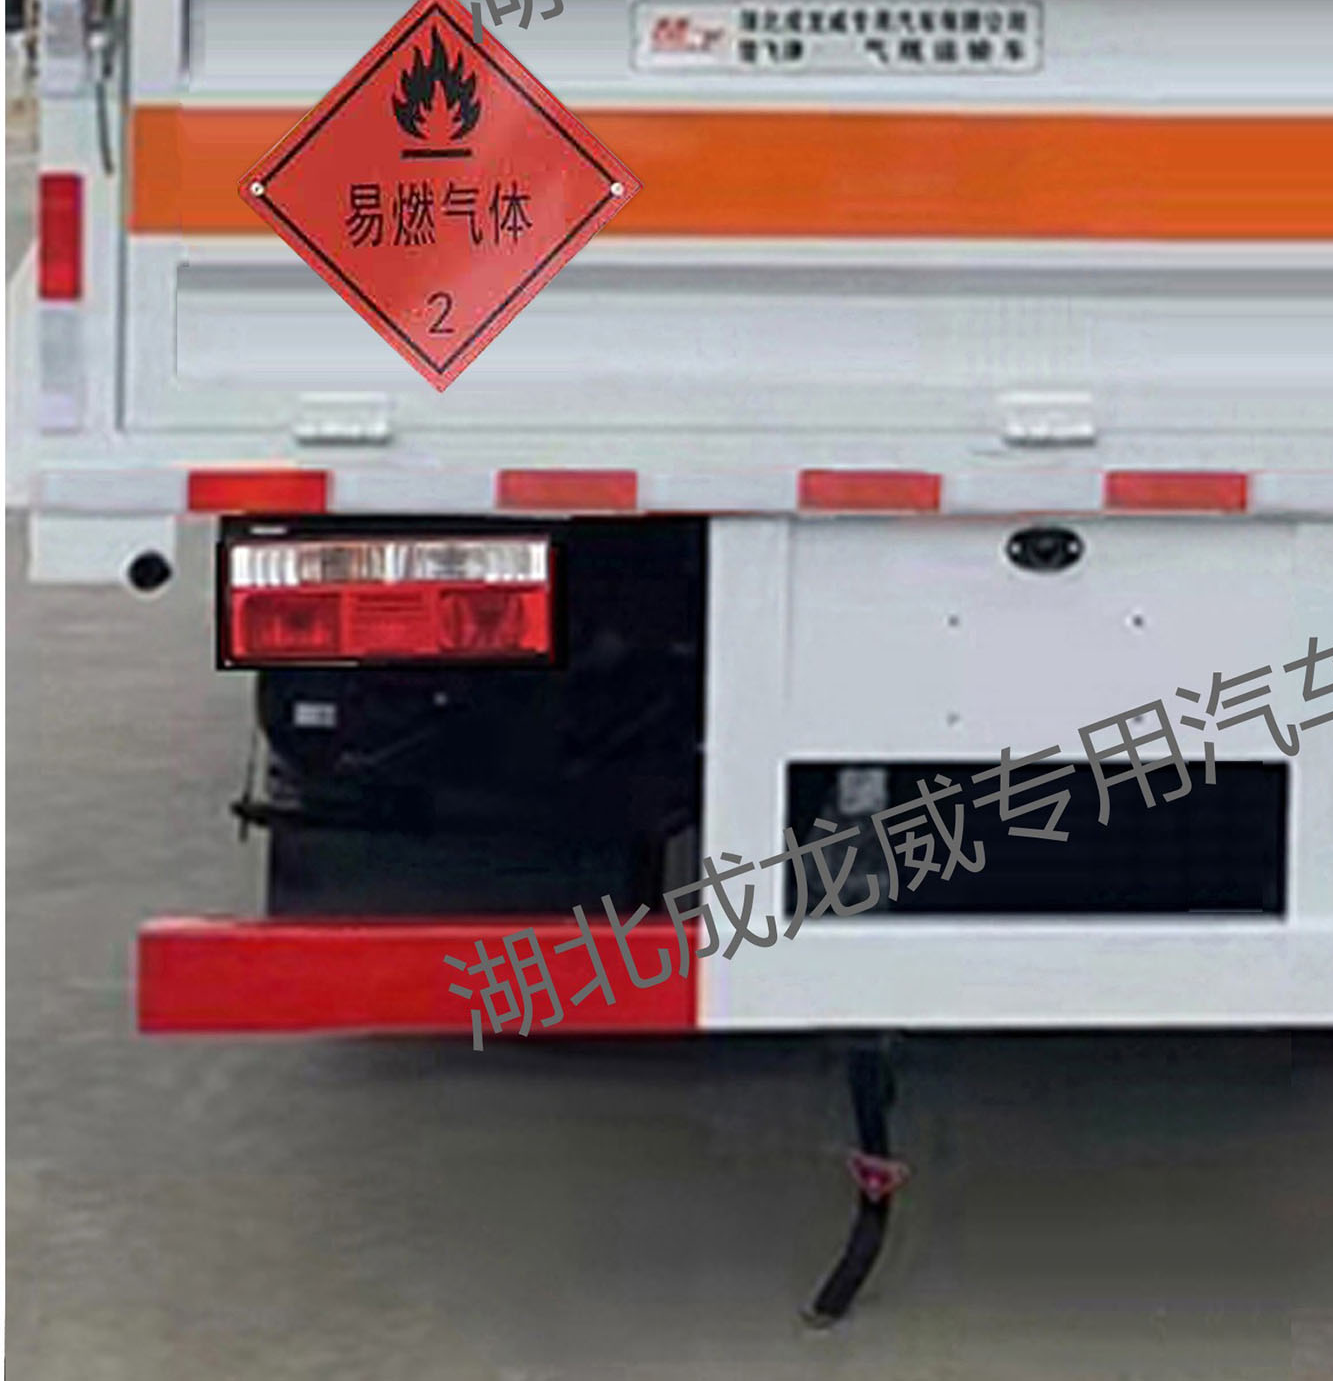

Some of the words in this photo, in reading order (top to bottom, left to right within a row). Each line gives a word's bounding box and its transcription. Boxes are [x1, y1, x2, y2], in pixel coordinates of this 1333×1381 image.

[345, 180, 534, 246] 易燃气体
[429, 292, 454, 334] 2
